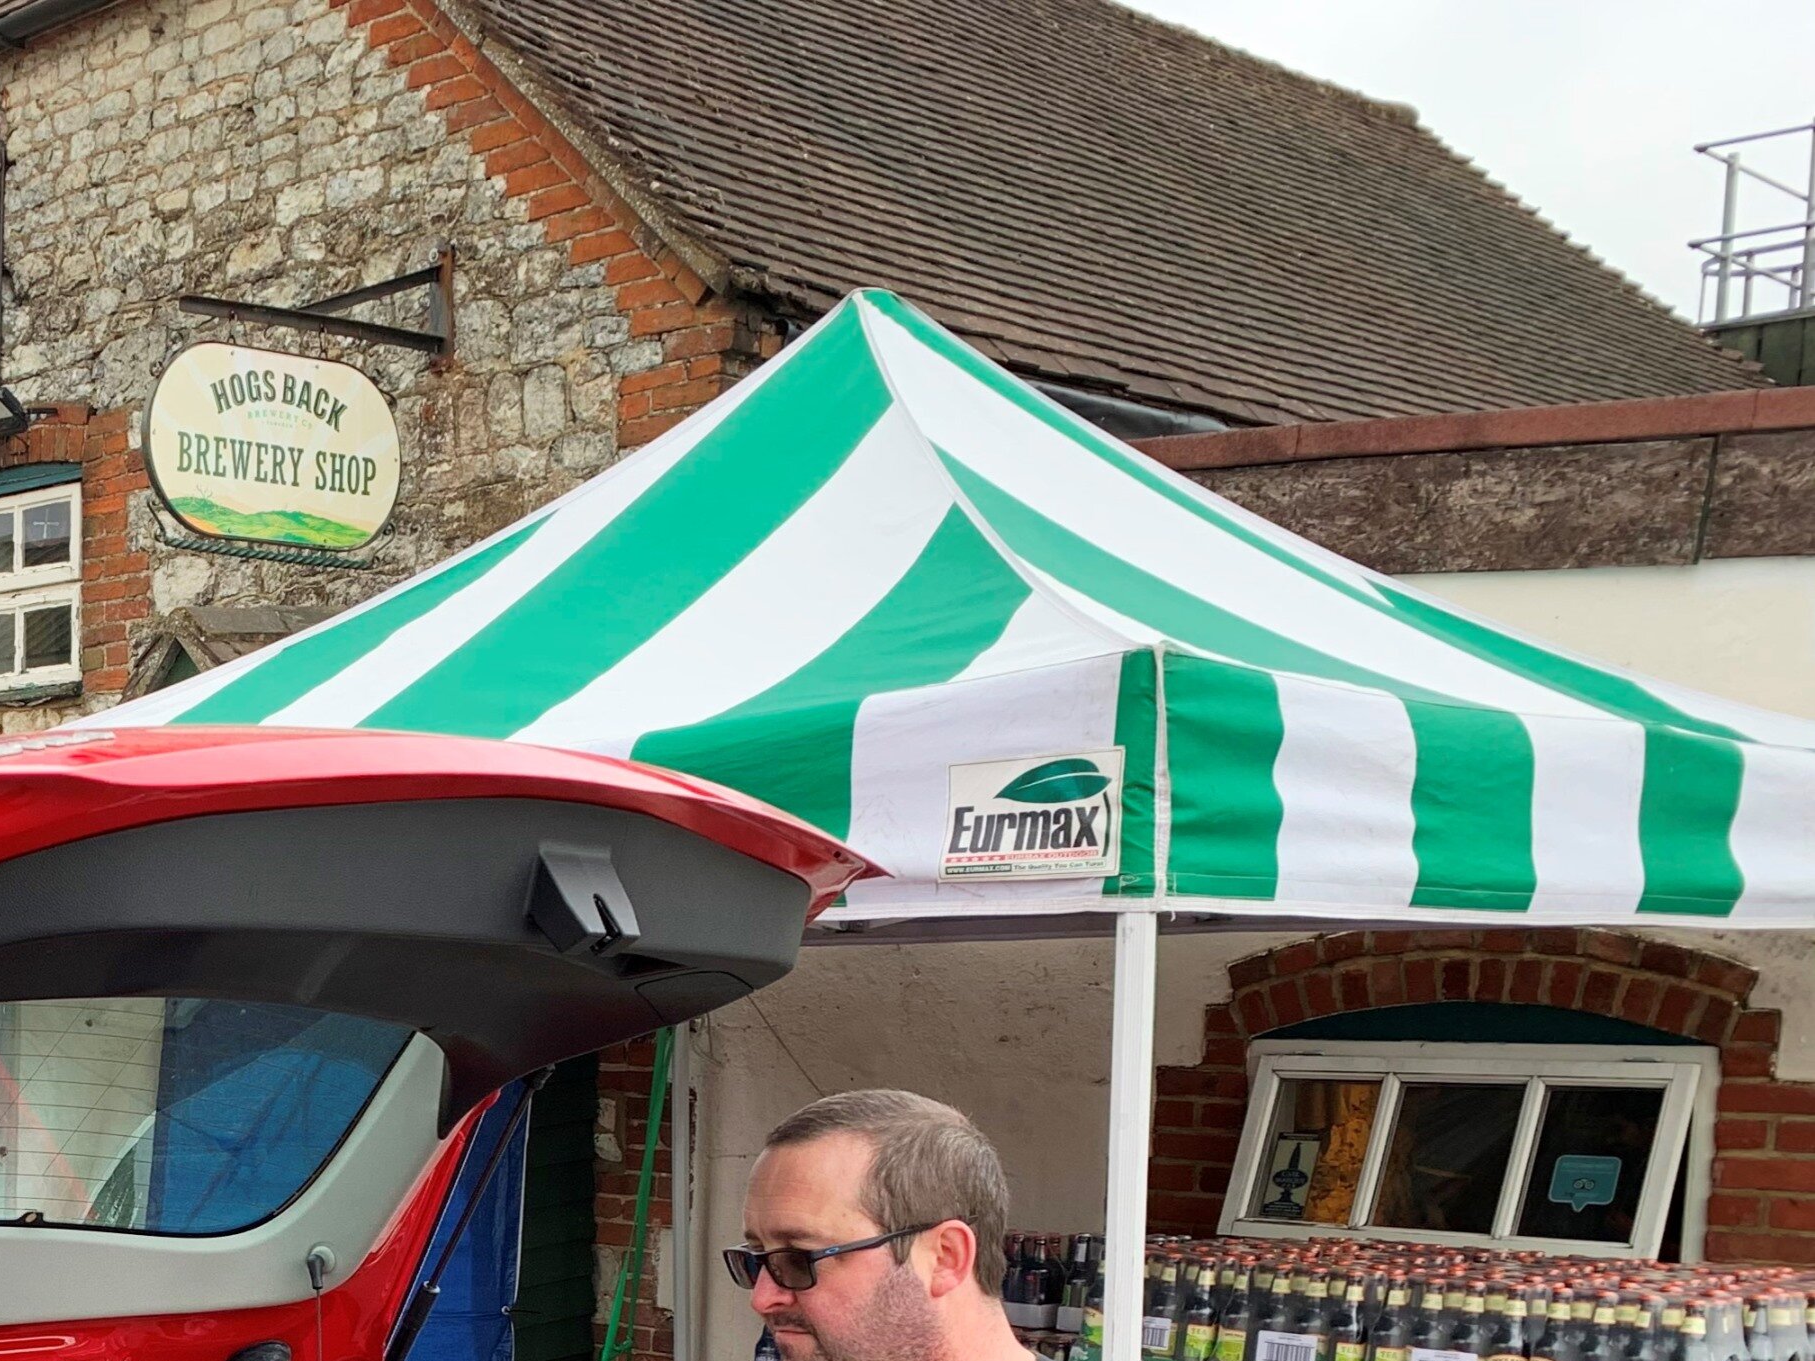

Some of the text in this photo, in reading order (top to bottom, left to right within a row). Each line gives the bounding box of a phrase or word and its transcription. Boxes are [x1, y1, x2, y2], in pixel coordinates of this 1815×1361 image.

[210, 369, 348, 432] HOGS BACK
[176, 430, 378, 497] BREWERY SHOP
[948, 805, 1101, 854] Eurmax
[946, 864, 1012, 874] WWW.EURMAX.COM
[1191, 1327, 1208, 1335] TEA
[1380, 1351, 1398, 1359] TEA
